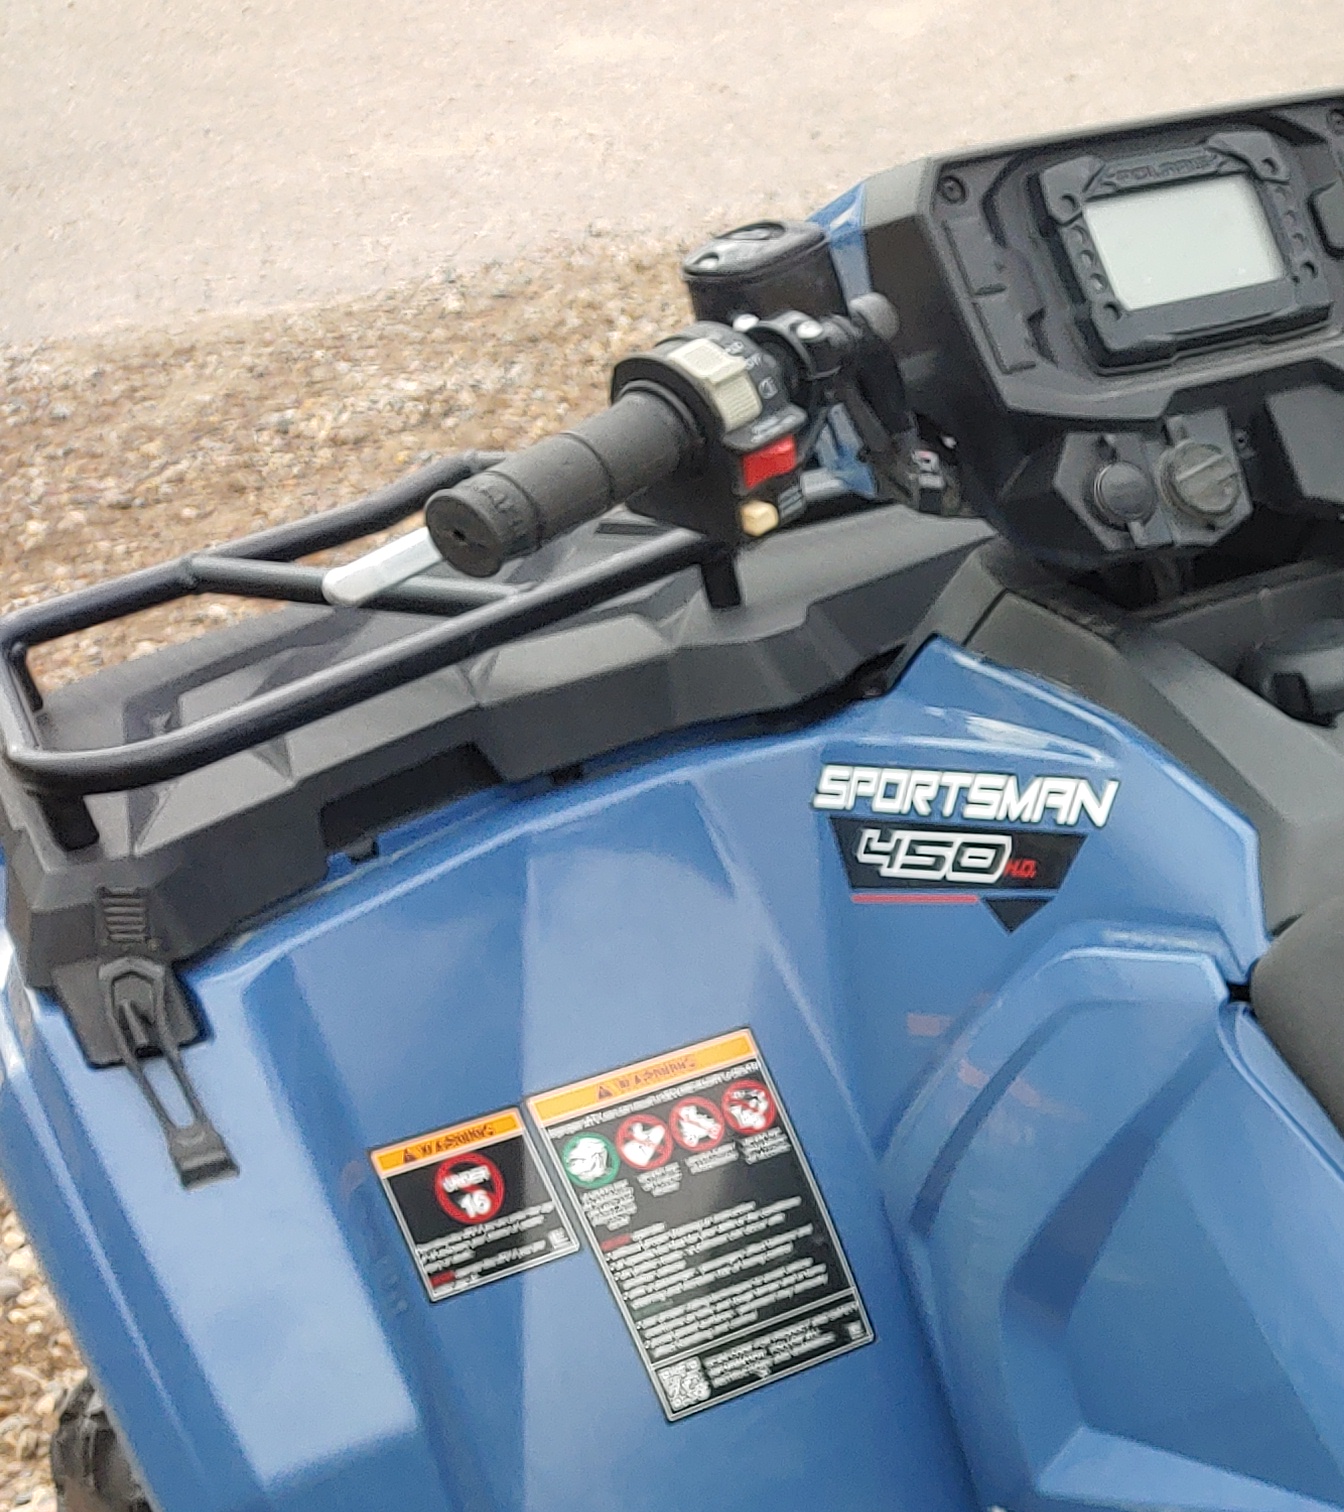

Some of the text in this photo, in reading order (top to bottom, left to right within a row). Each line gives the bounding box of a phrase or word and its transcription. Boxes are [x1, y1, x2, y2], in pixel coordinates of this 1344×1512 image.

[812, 764, 1120, 828] SPORTSMAN
[856, 828, 1013, 884] 450
[459, 1189, 492, 1219] 16
